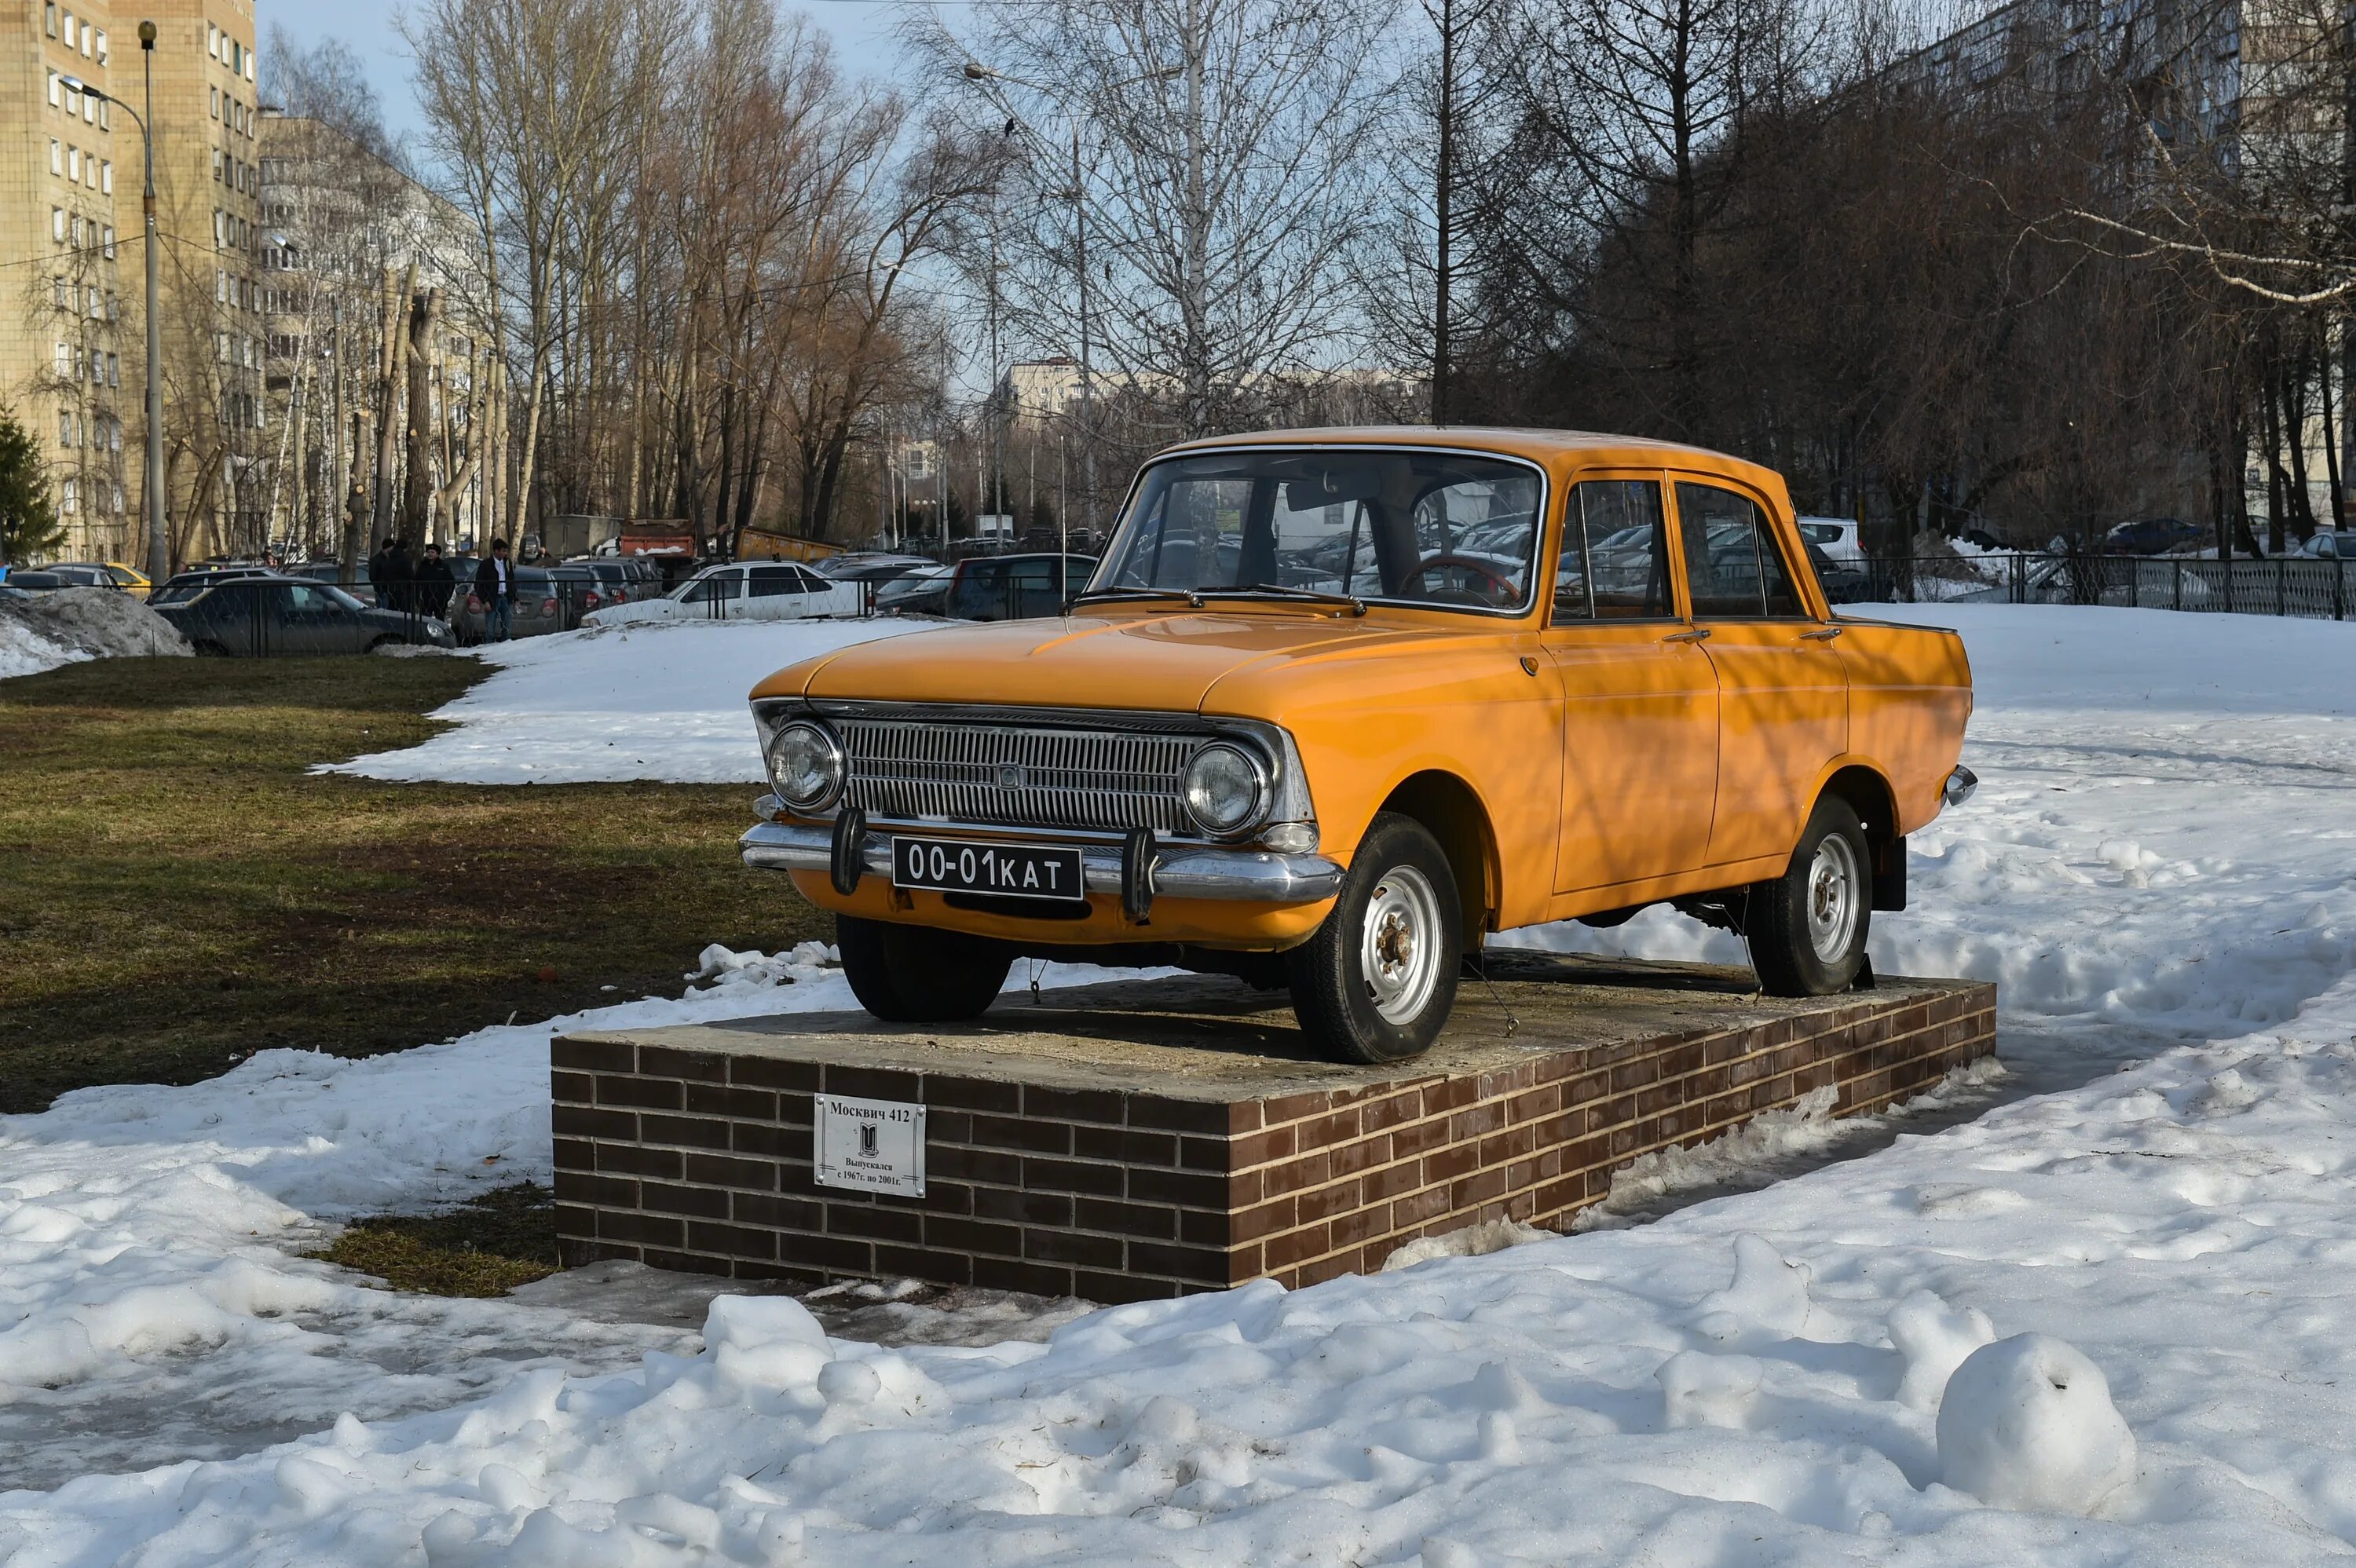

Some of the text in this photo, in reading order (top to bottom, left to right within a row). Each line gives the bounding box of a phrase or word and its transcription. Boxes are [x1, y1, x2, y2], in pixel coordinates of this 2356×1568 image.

[830, 1102, 909, 1123] Москвич 412
[846, 1157, 893, 1171] Выпускался
[843, 1171, 865, 1181] 1967г.
[879, 1175, 902, 1186] 2001г.
